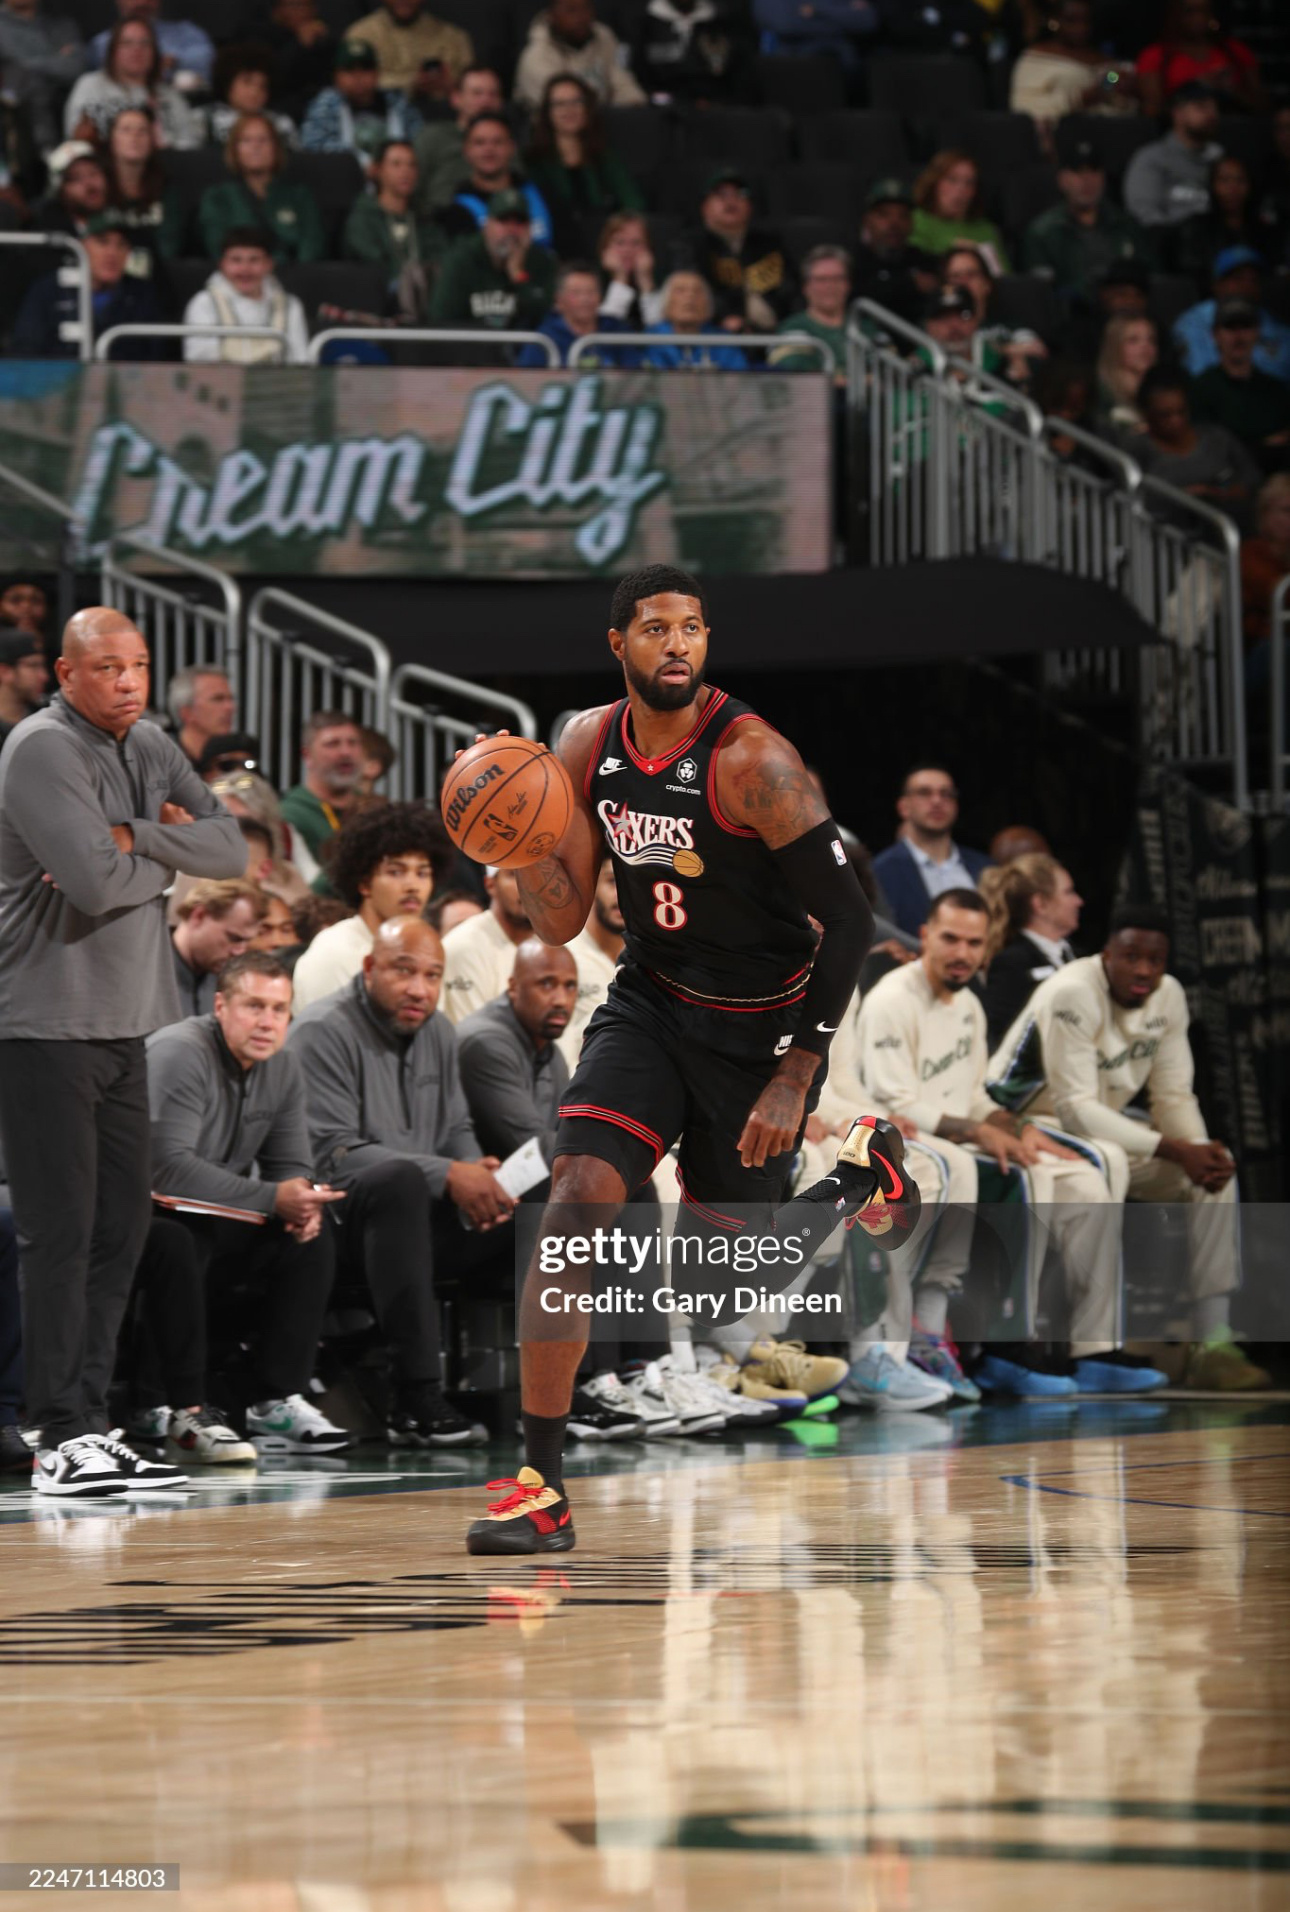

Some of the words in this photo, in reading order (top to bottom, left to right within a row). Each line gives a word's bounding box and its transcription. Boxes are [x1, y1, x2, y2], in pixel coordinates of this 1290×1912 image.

[70, 424, 427, 563] Cream
[448, 376, 664, 565] City
[445, 763, 505, 832] Wilson
[665, 784, 702, 796] crypto.com
[652, 880, 688, 931] 8
